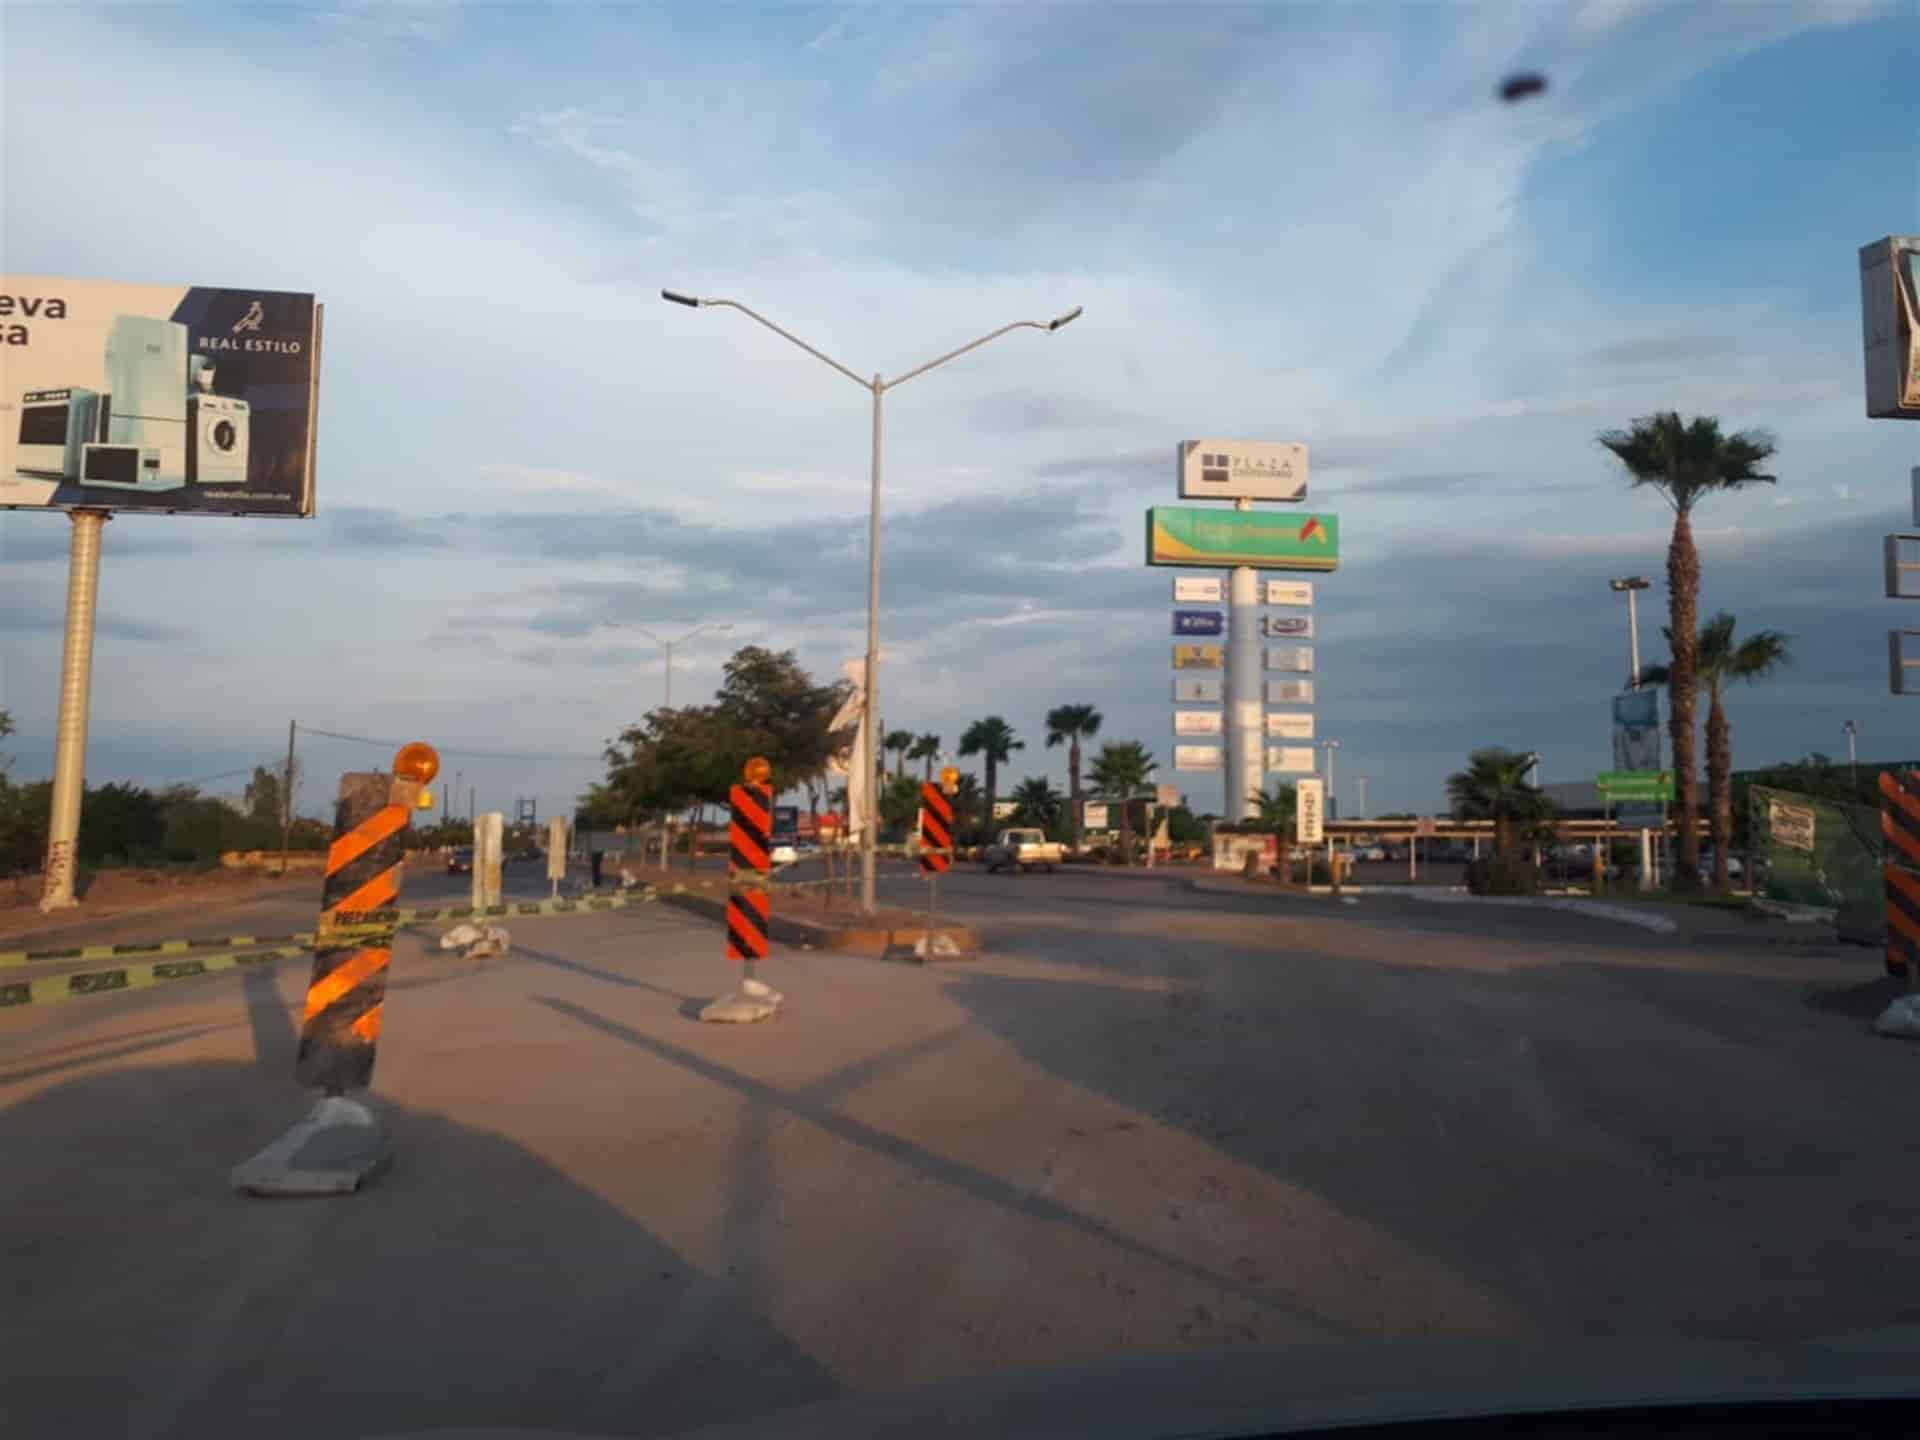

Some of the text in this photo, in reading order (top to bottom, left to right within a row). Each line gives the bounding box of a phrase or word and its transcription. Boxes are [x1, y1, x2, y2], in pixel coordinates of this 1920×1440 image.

[0, 324, 28, 346] a
[200, 336, 301, 354] REAL ESTILO
[1233, 457, 1292, 471] PLAZA
